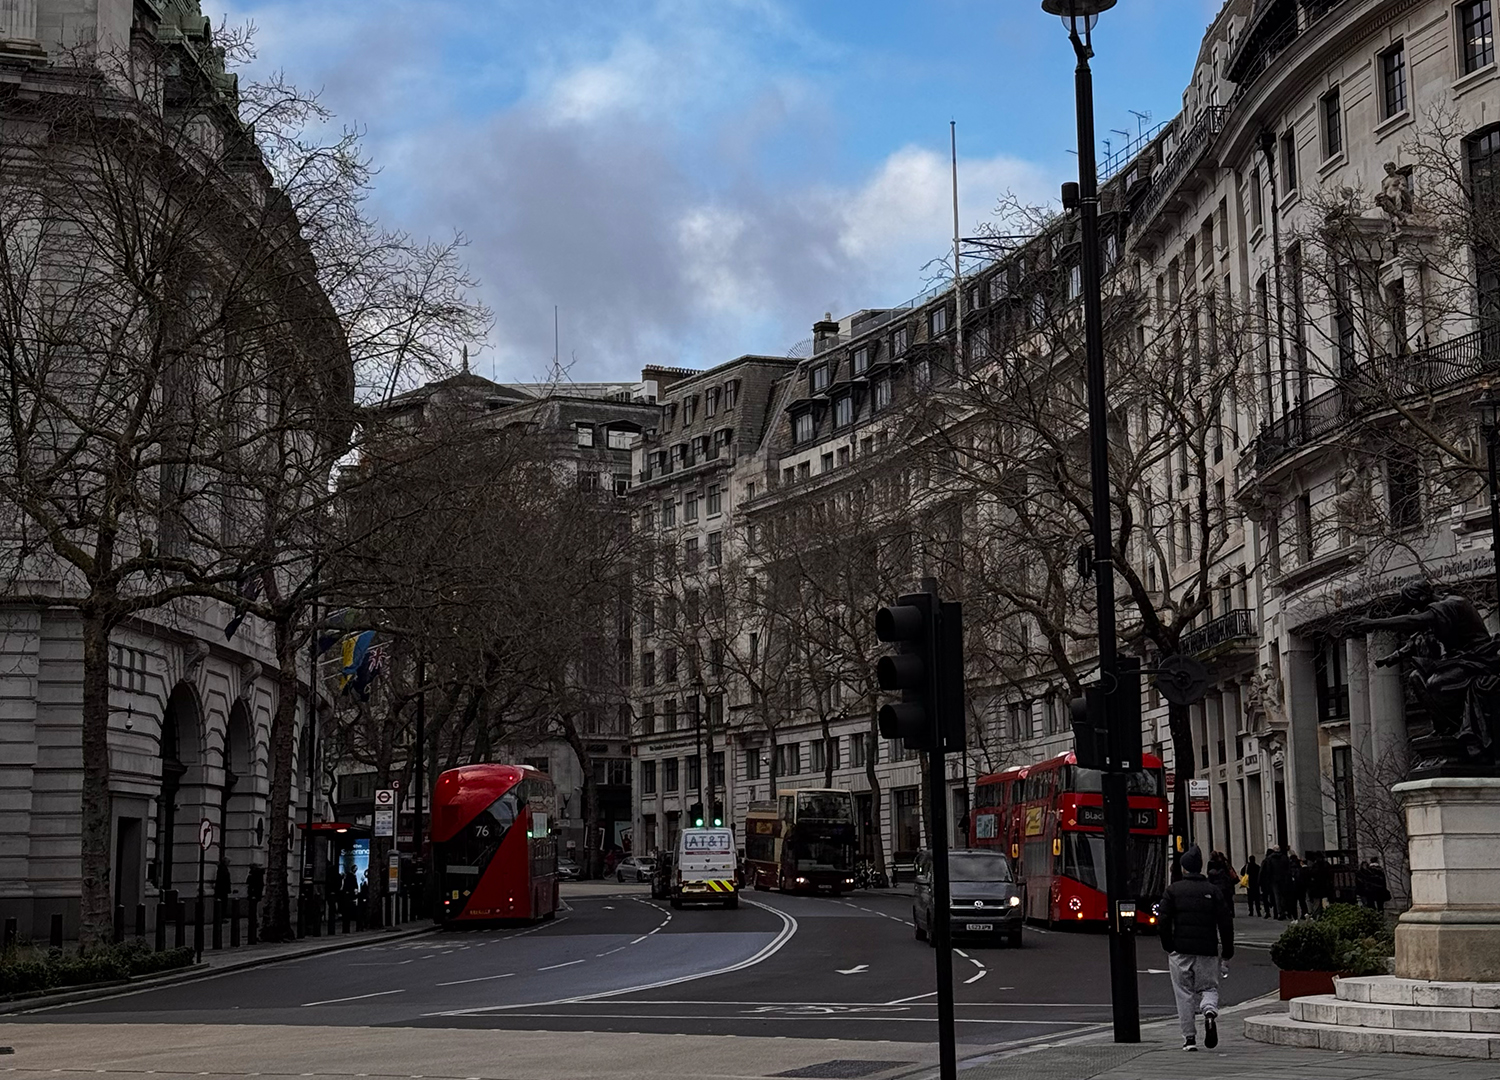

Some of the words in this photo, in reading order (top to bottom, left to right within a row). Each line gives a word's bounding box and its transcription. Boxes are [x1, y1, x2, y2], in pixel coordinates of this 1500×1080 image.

[392, 780, 399, 788] G
[1138, 811, 1149, 824] 15
[475, 825, 489, 837] 76
[689, 835, 726, 847] AT&T
